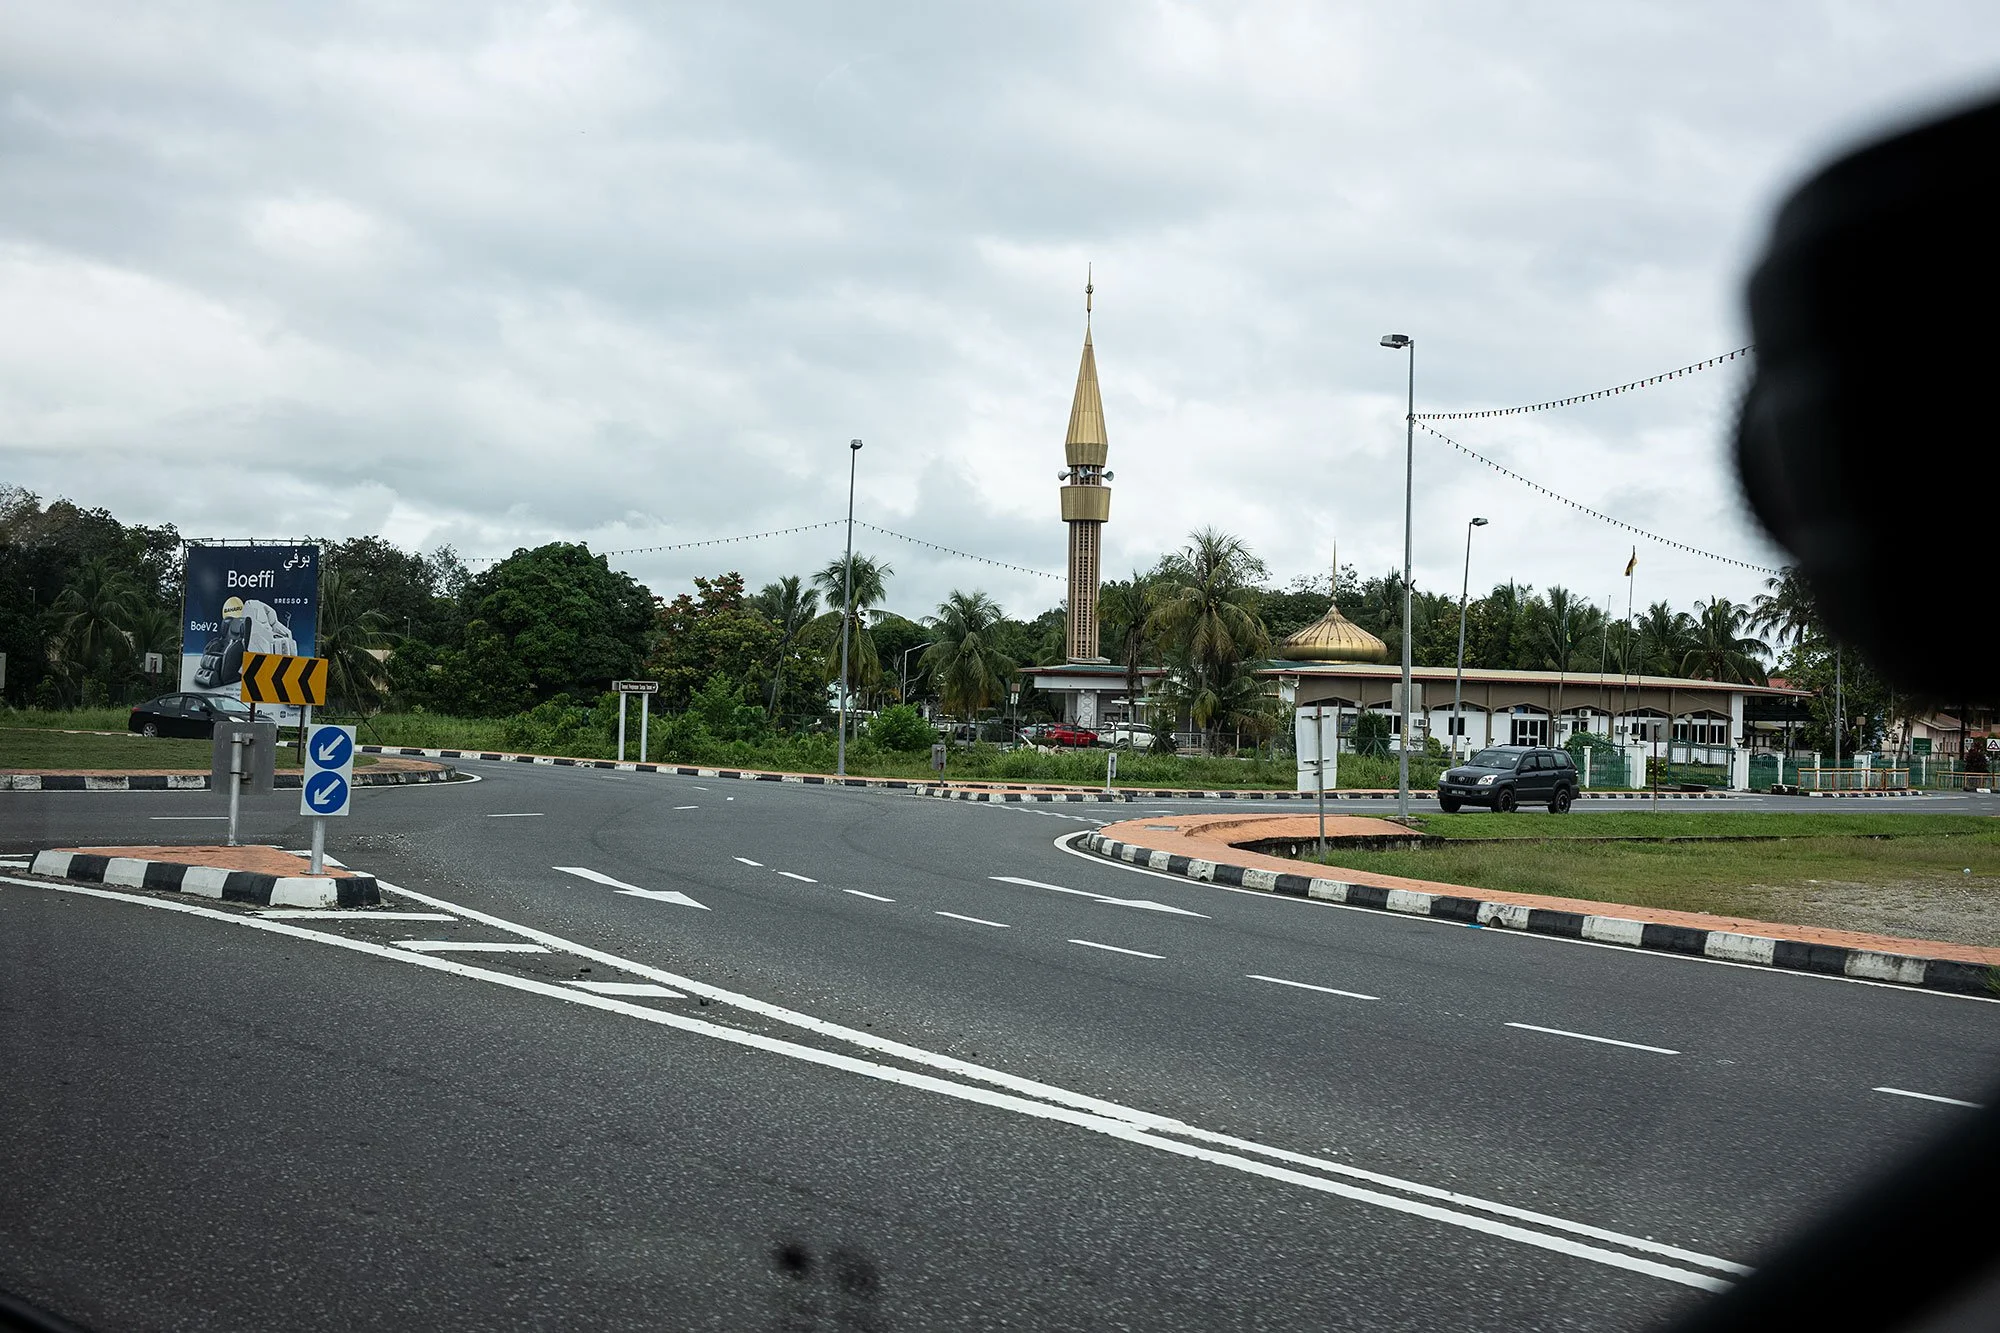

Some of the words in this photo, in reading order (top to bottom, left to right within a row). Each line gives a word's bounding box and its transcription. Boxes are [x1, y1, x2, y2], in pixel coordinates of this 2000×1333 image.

[283, 549, 310, 571] بوفي
[227, 570, 275, 588] Boeffi
[223, 606, 243, 614] BAHARU
